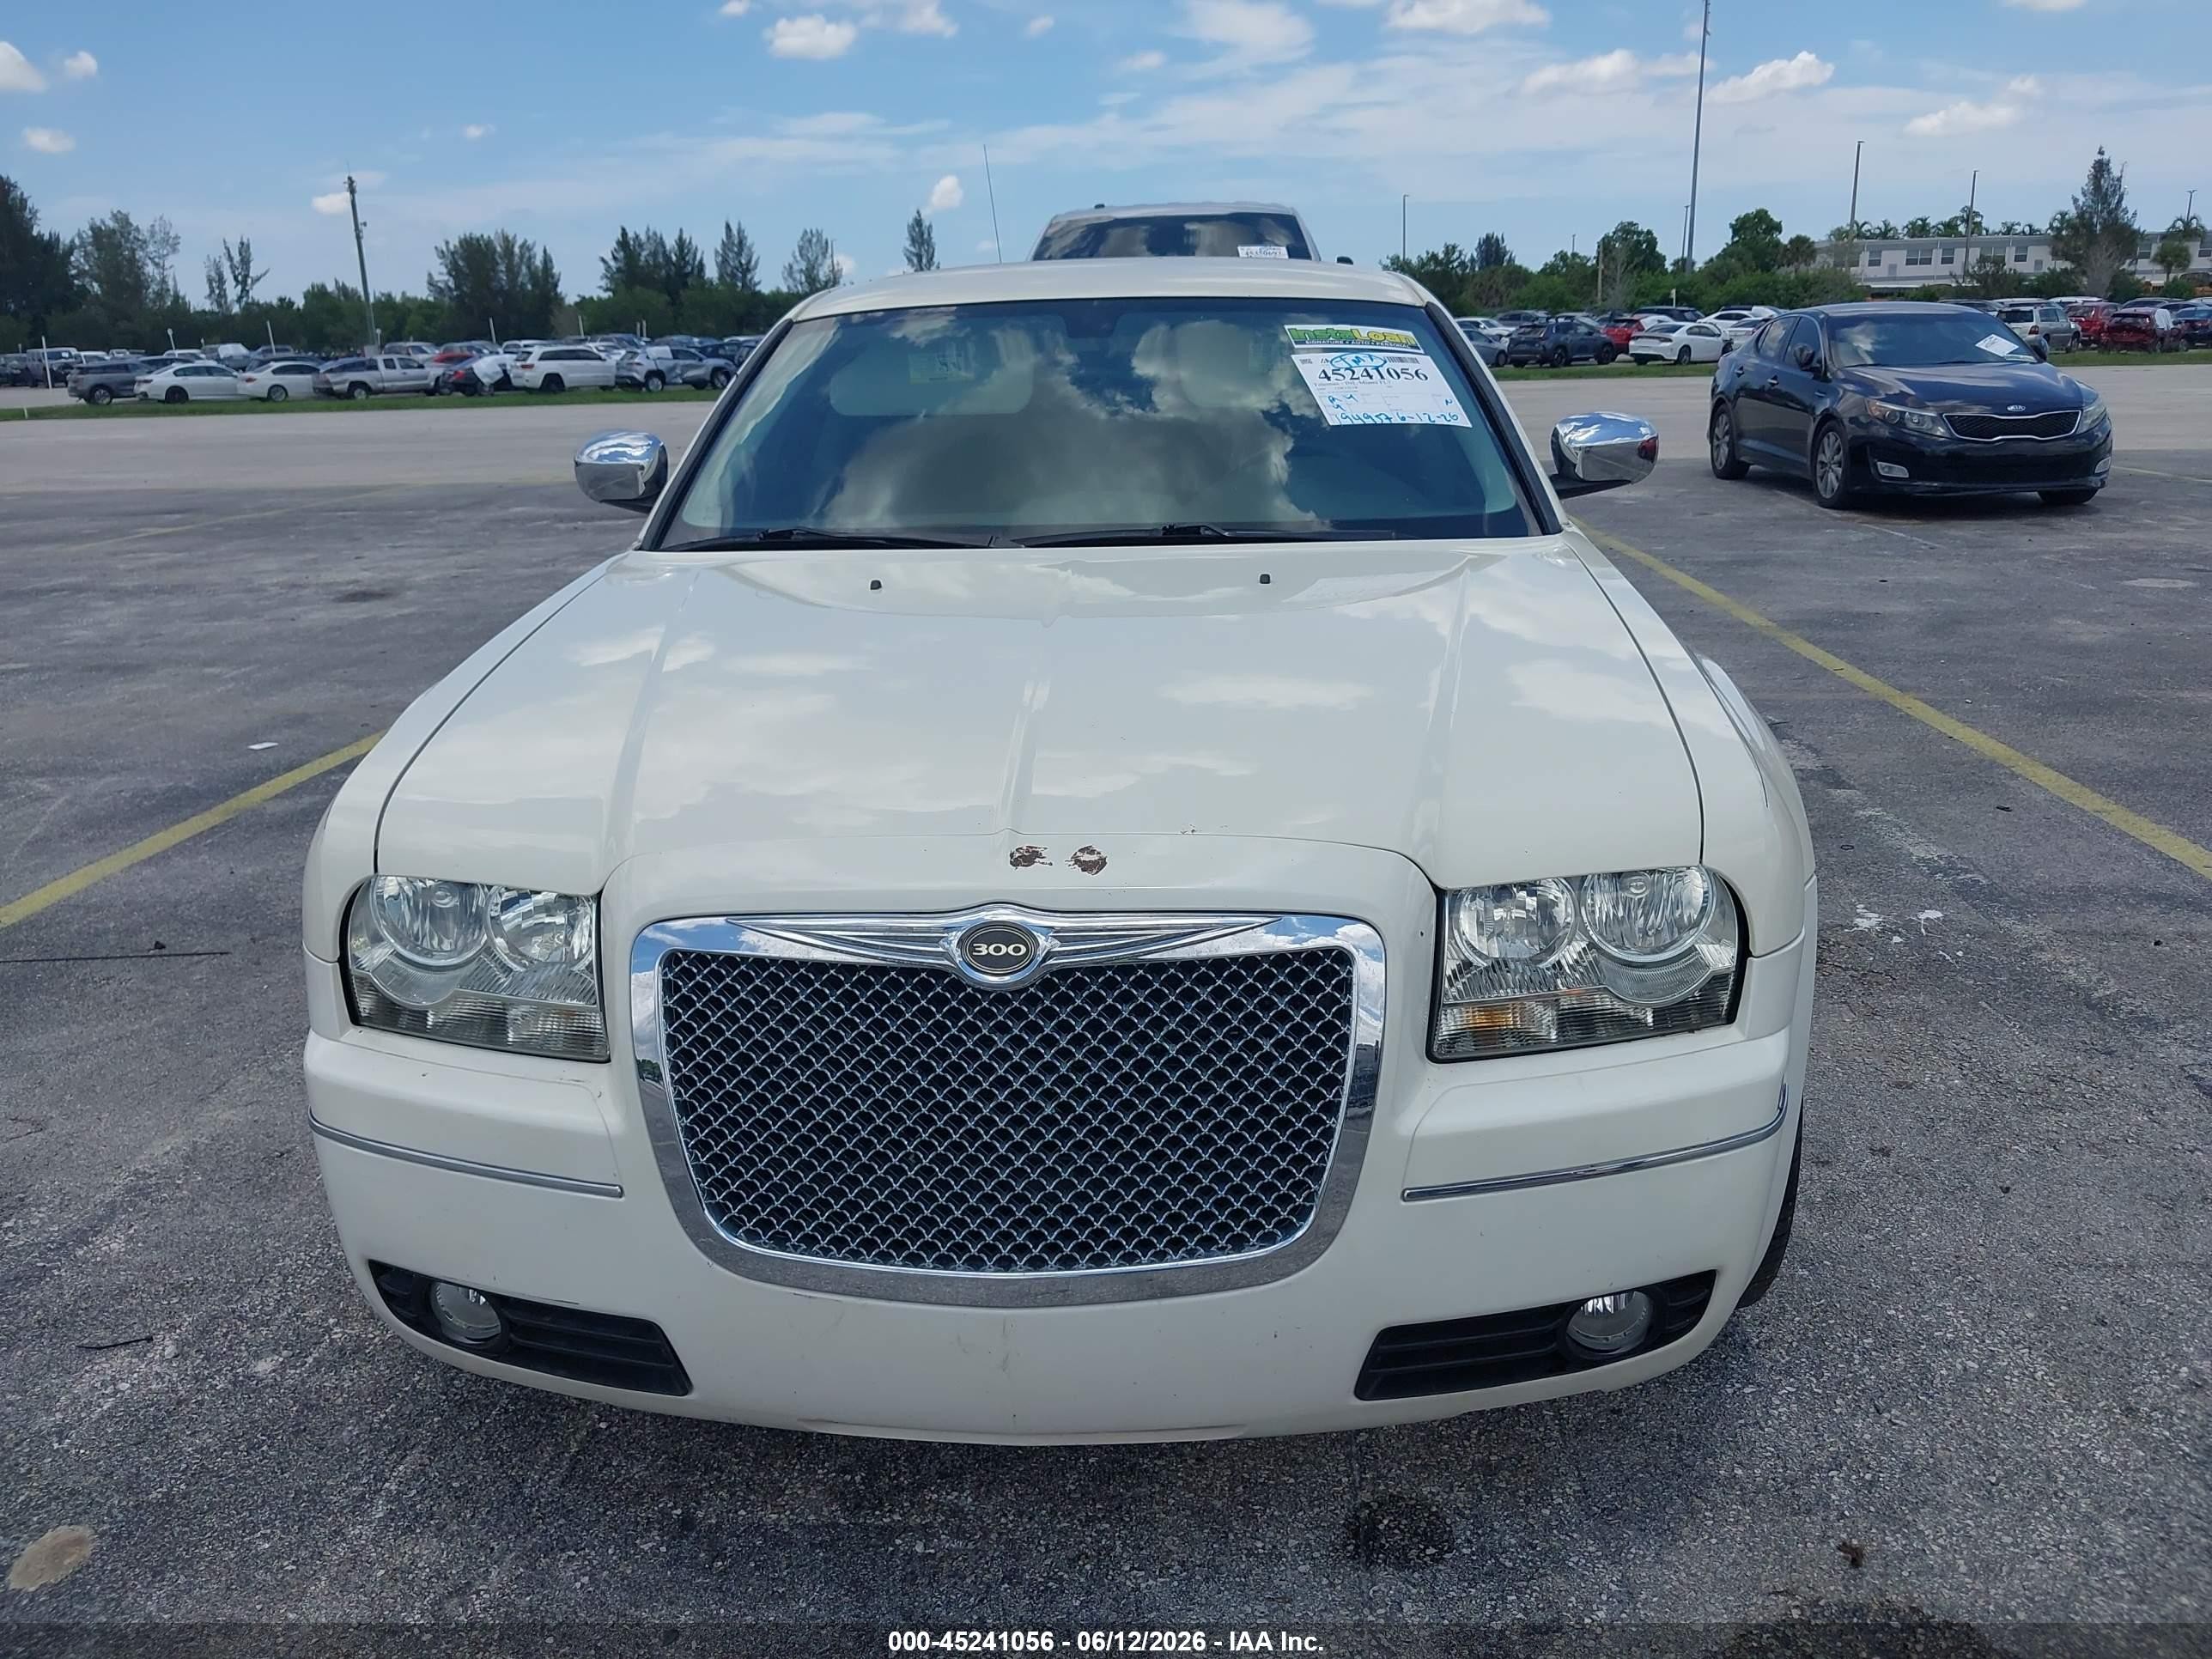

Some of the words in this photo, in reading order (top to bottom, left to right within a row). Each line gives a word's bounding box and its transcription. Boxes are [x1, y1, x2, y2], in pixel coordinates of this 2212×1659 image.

[1288, 327, 1417, 347] InstaLoan
[1318, 366, 1429, 381] 45241056
[972, 943, 1027, 957] 300
